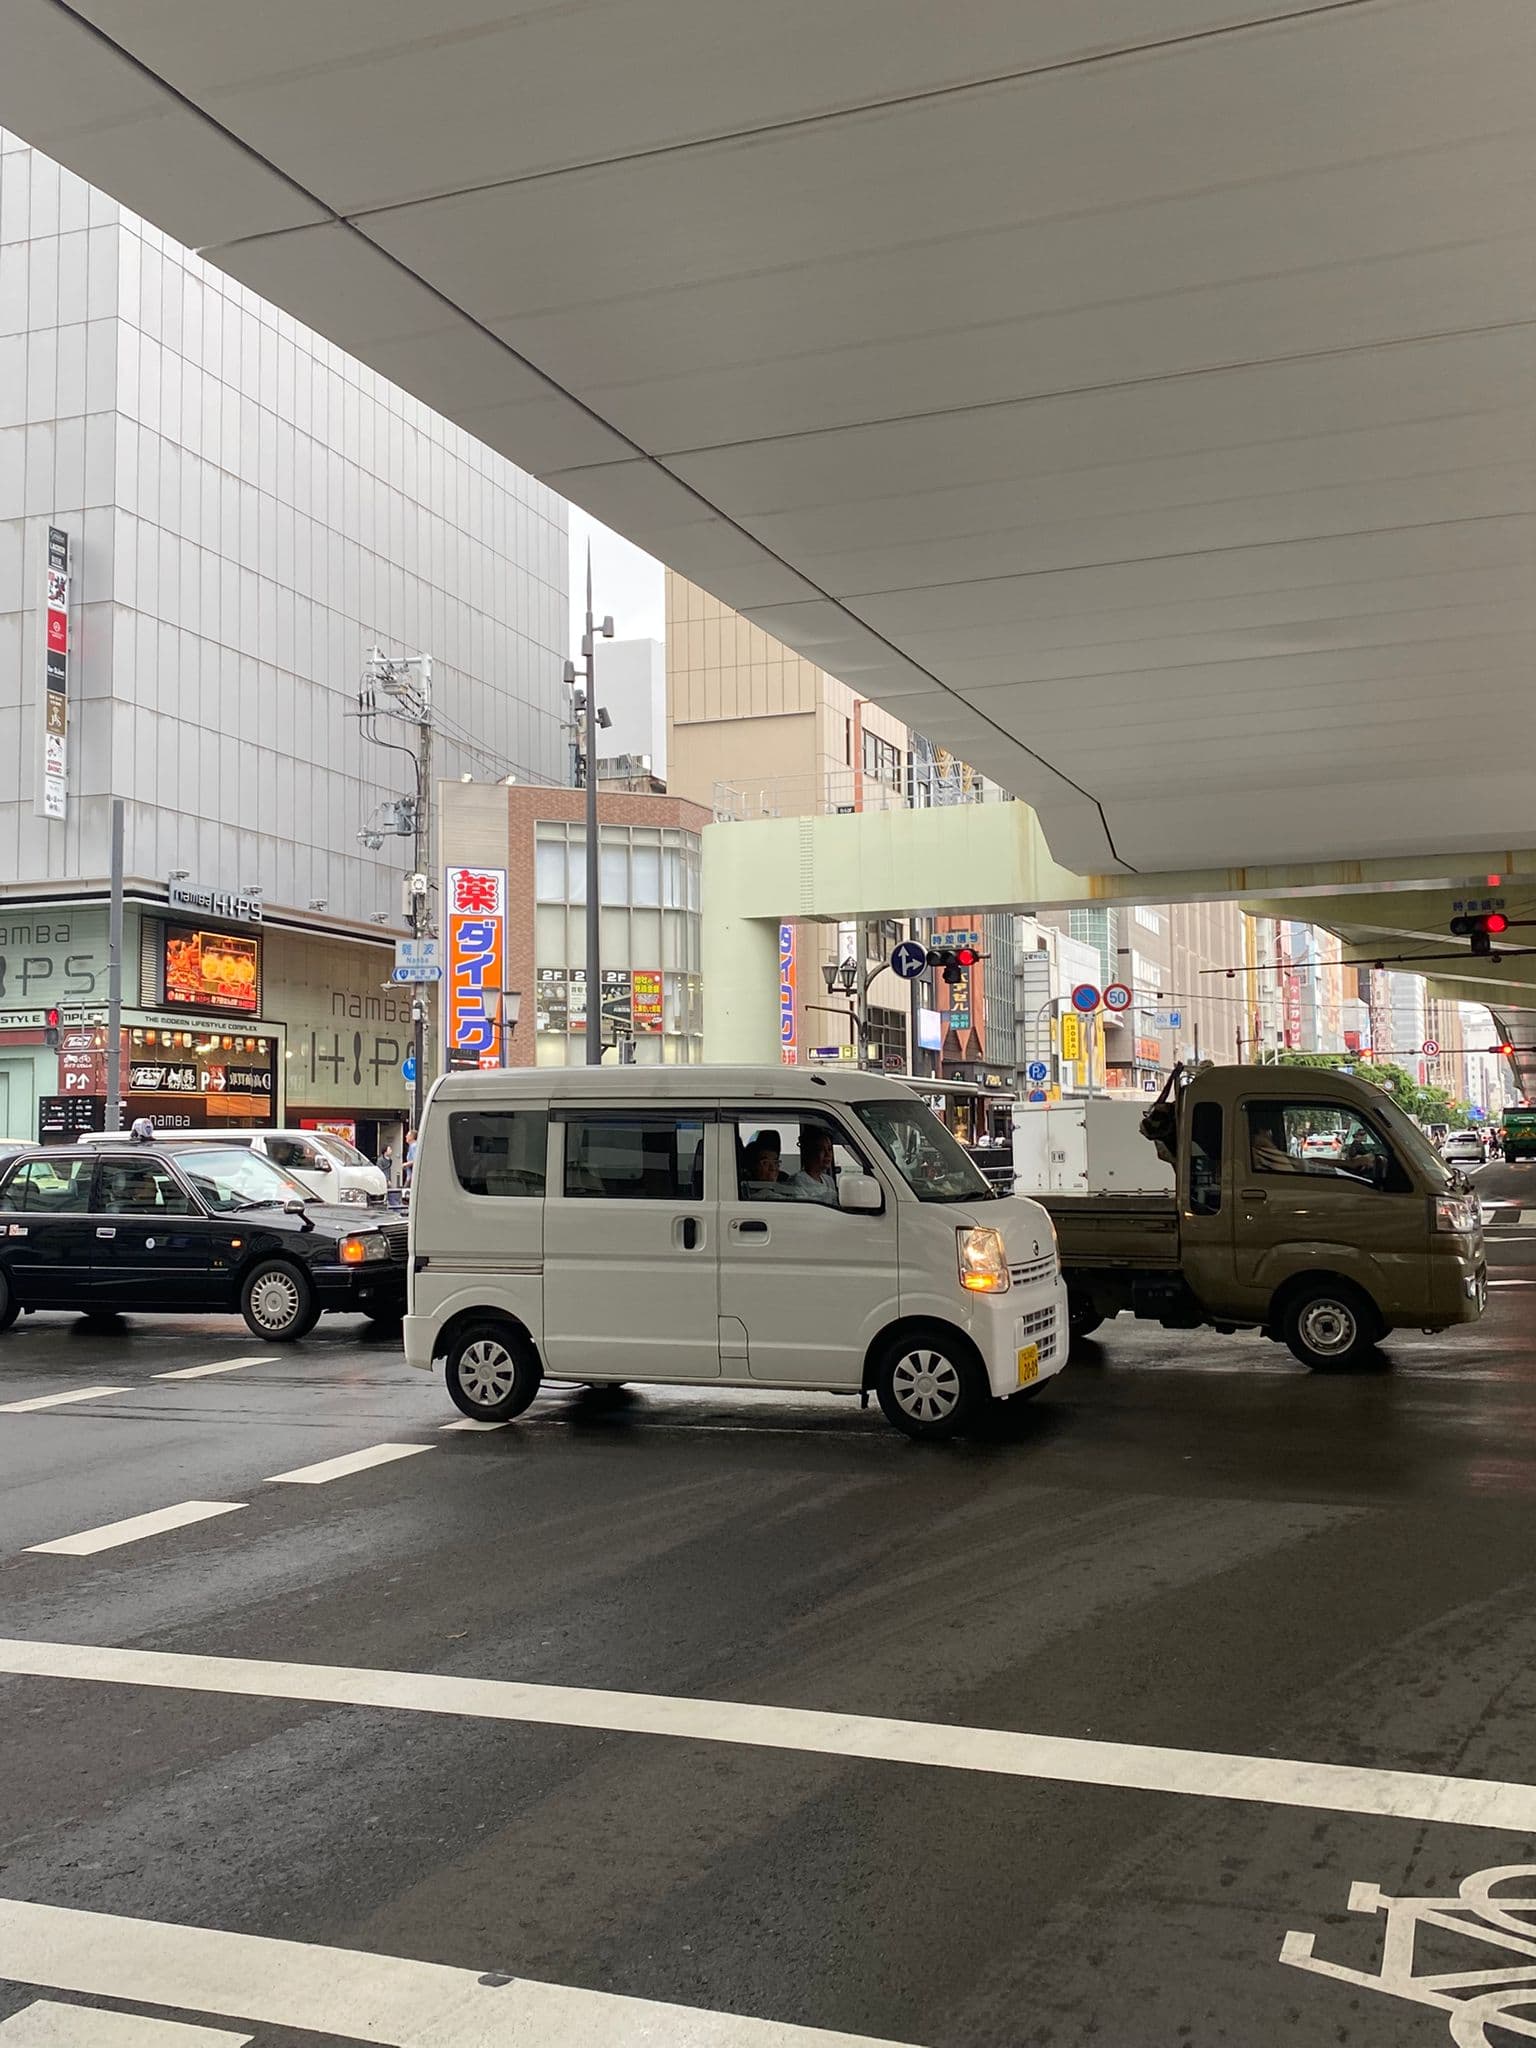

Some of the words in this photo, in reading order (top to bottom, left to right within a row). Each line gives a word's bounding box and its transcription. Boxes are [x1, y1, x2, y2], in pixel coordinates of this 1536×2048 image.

[456, 869, 496, 911] 薬
[401, 943, 435, 955] 難波
[0, 955, 95, 997] IPS
[542, 970, 563, 980] 2F
[575, 971, 586, 981] 2
[607, 972, 627, 982] 2F
[781, 925, 793, 1041] ダイコク
[456, 920, 496, 1051] ダイコク
[1109, 991, 1126, 1004] 50
[0, 1015, 41, 1023] STYLE
[145, 1015, 159, 1023] THE
[160, 1017, 190, 1026] MODERN
[191, 1019, 227, 1029] LIFESTYLE
[228, 1023, 257, 1032] COMPLEX
[66, 1073, 77, 1089] P
[201, 1072, 210, 1091] P
